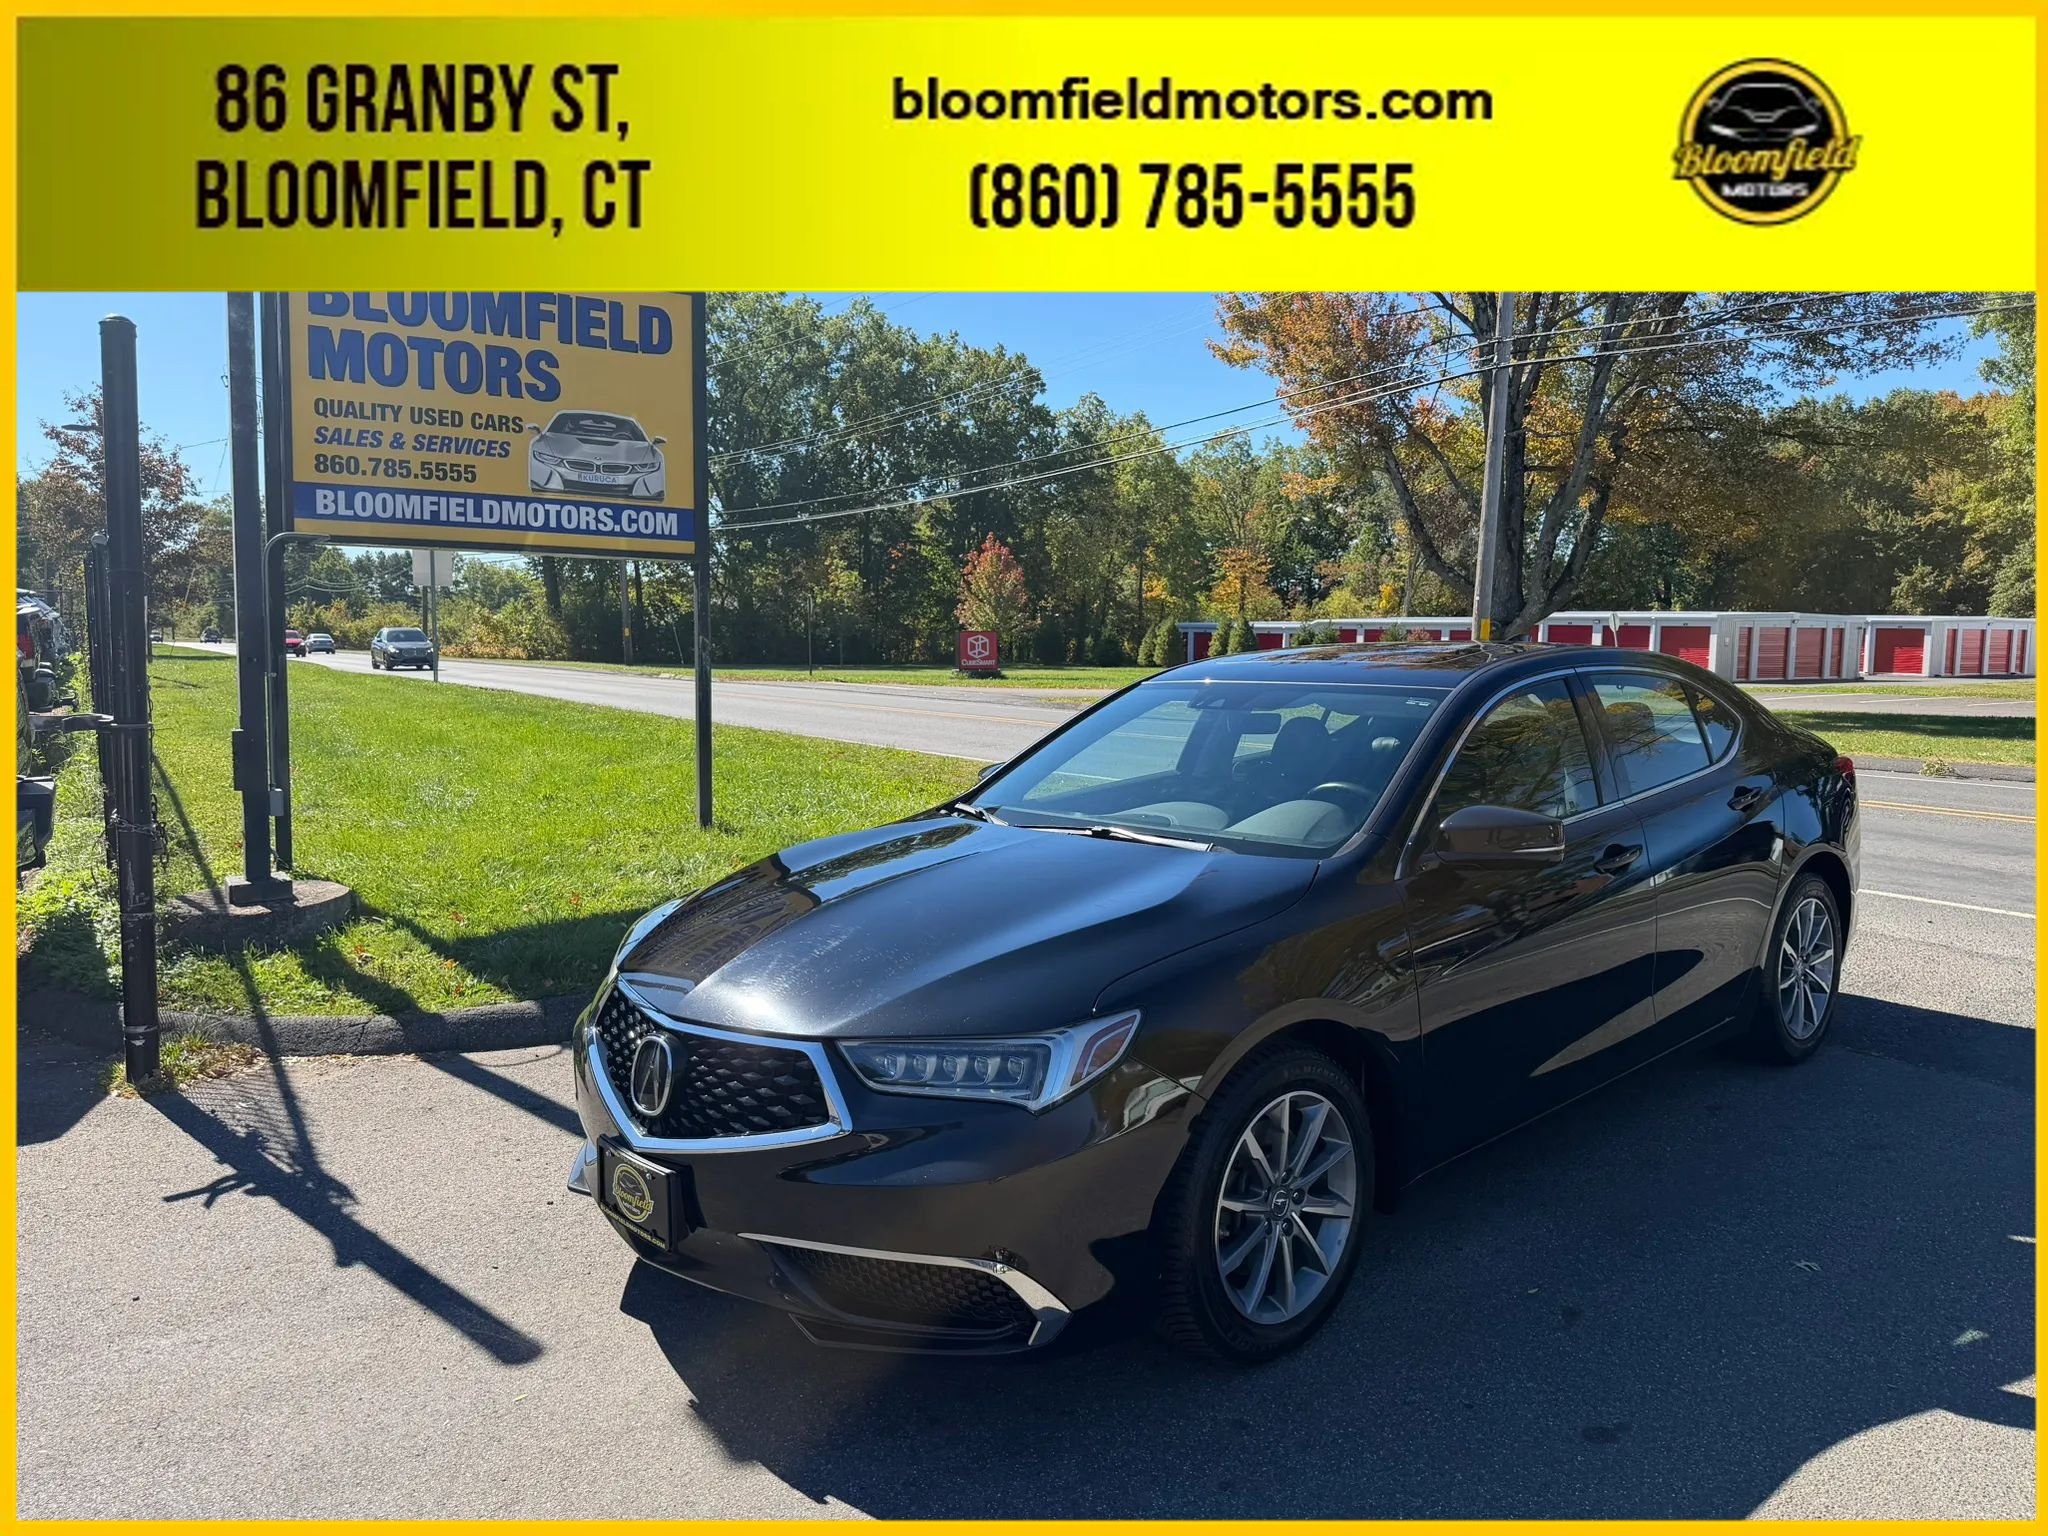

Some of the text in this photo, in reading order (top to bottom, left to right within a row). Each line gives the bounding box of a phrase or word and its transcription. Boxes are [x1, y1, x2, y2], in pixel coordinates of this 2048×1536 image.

[307, 324, 562, 402] MOTORS
[313, 397, 524, 434] QUALITY USED CARS
[313, 425, 512, 458] SALES & SERVICES
[313, 452, 477, 483] 860.785.5555
[315, 488, 679, 537] BLOOMFIELDMOTORS.COM
